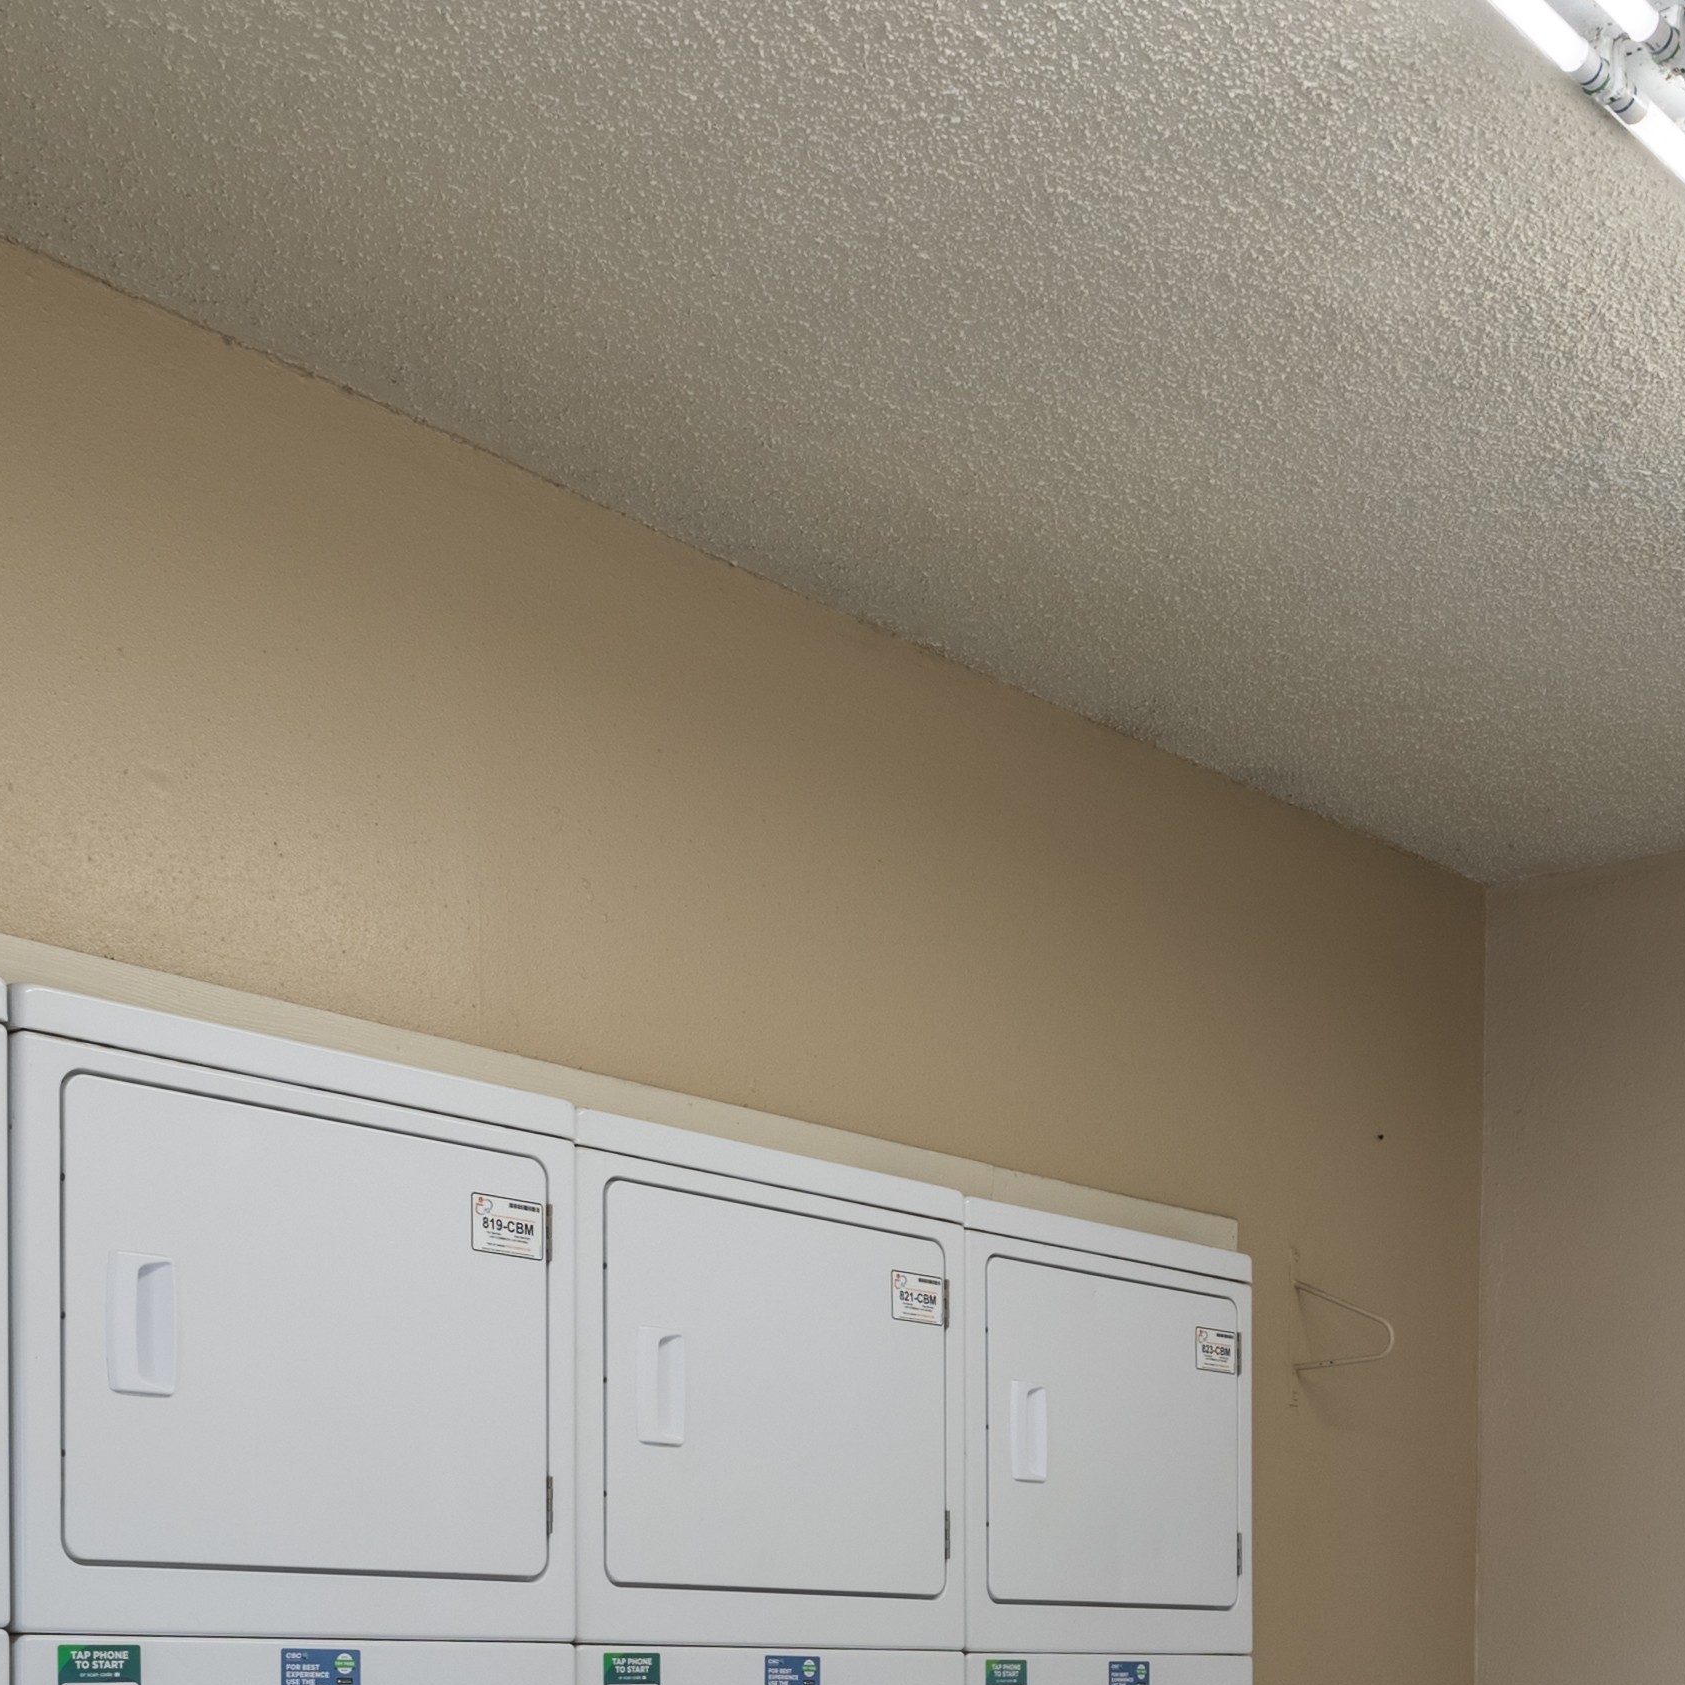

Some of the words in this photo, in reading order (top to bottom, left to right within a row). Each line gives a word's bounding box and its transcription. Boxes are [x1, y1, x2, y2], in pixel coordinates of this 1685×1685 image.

[482, 1217, 534, 1236] 819-CBM
[70, 1651, 91, 1659] TAP
[93, 1651, 129, 1659] PHONE
[75, 1661, 89, 1669] TO
[92, 1661, 125, 1669] START
